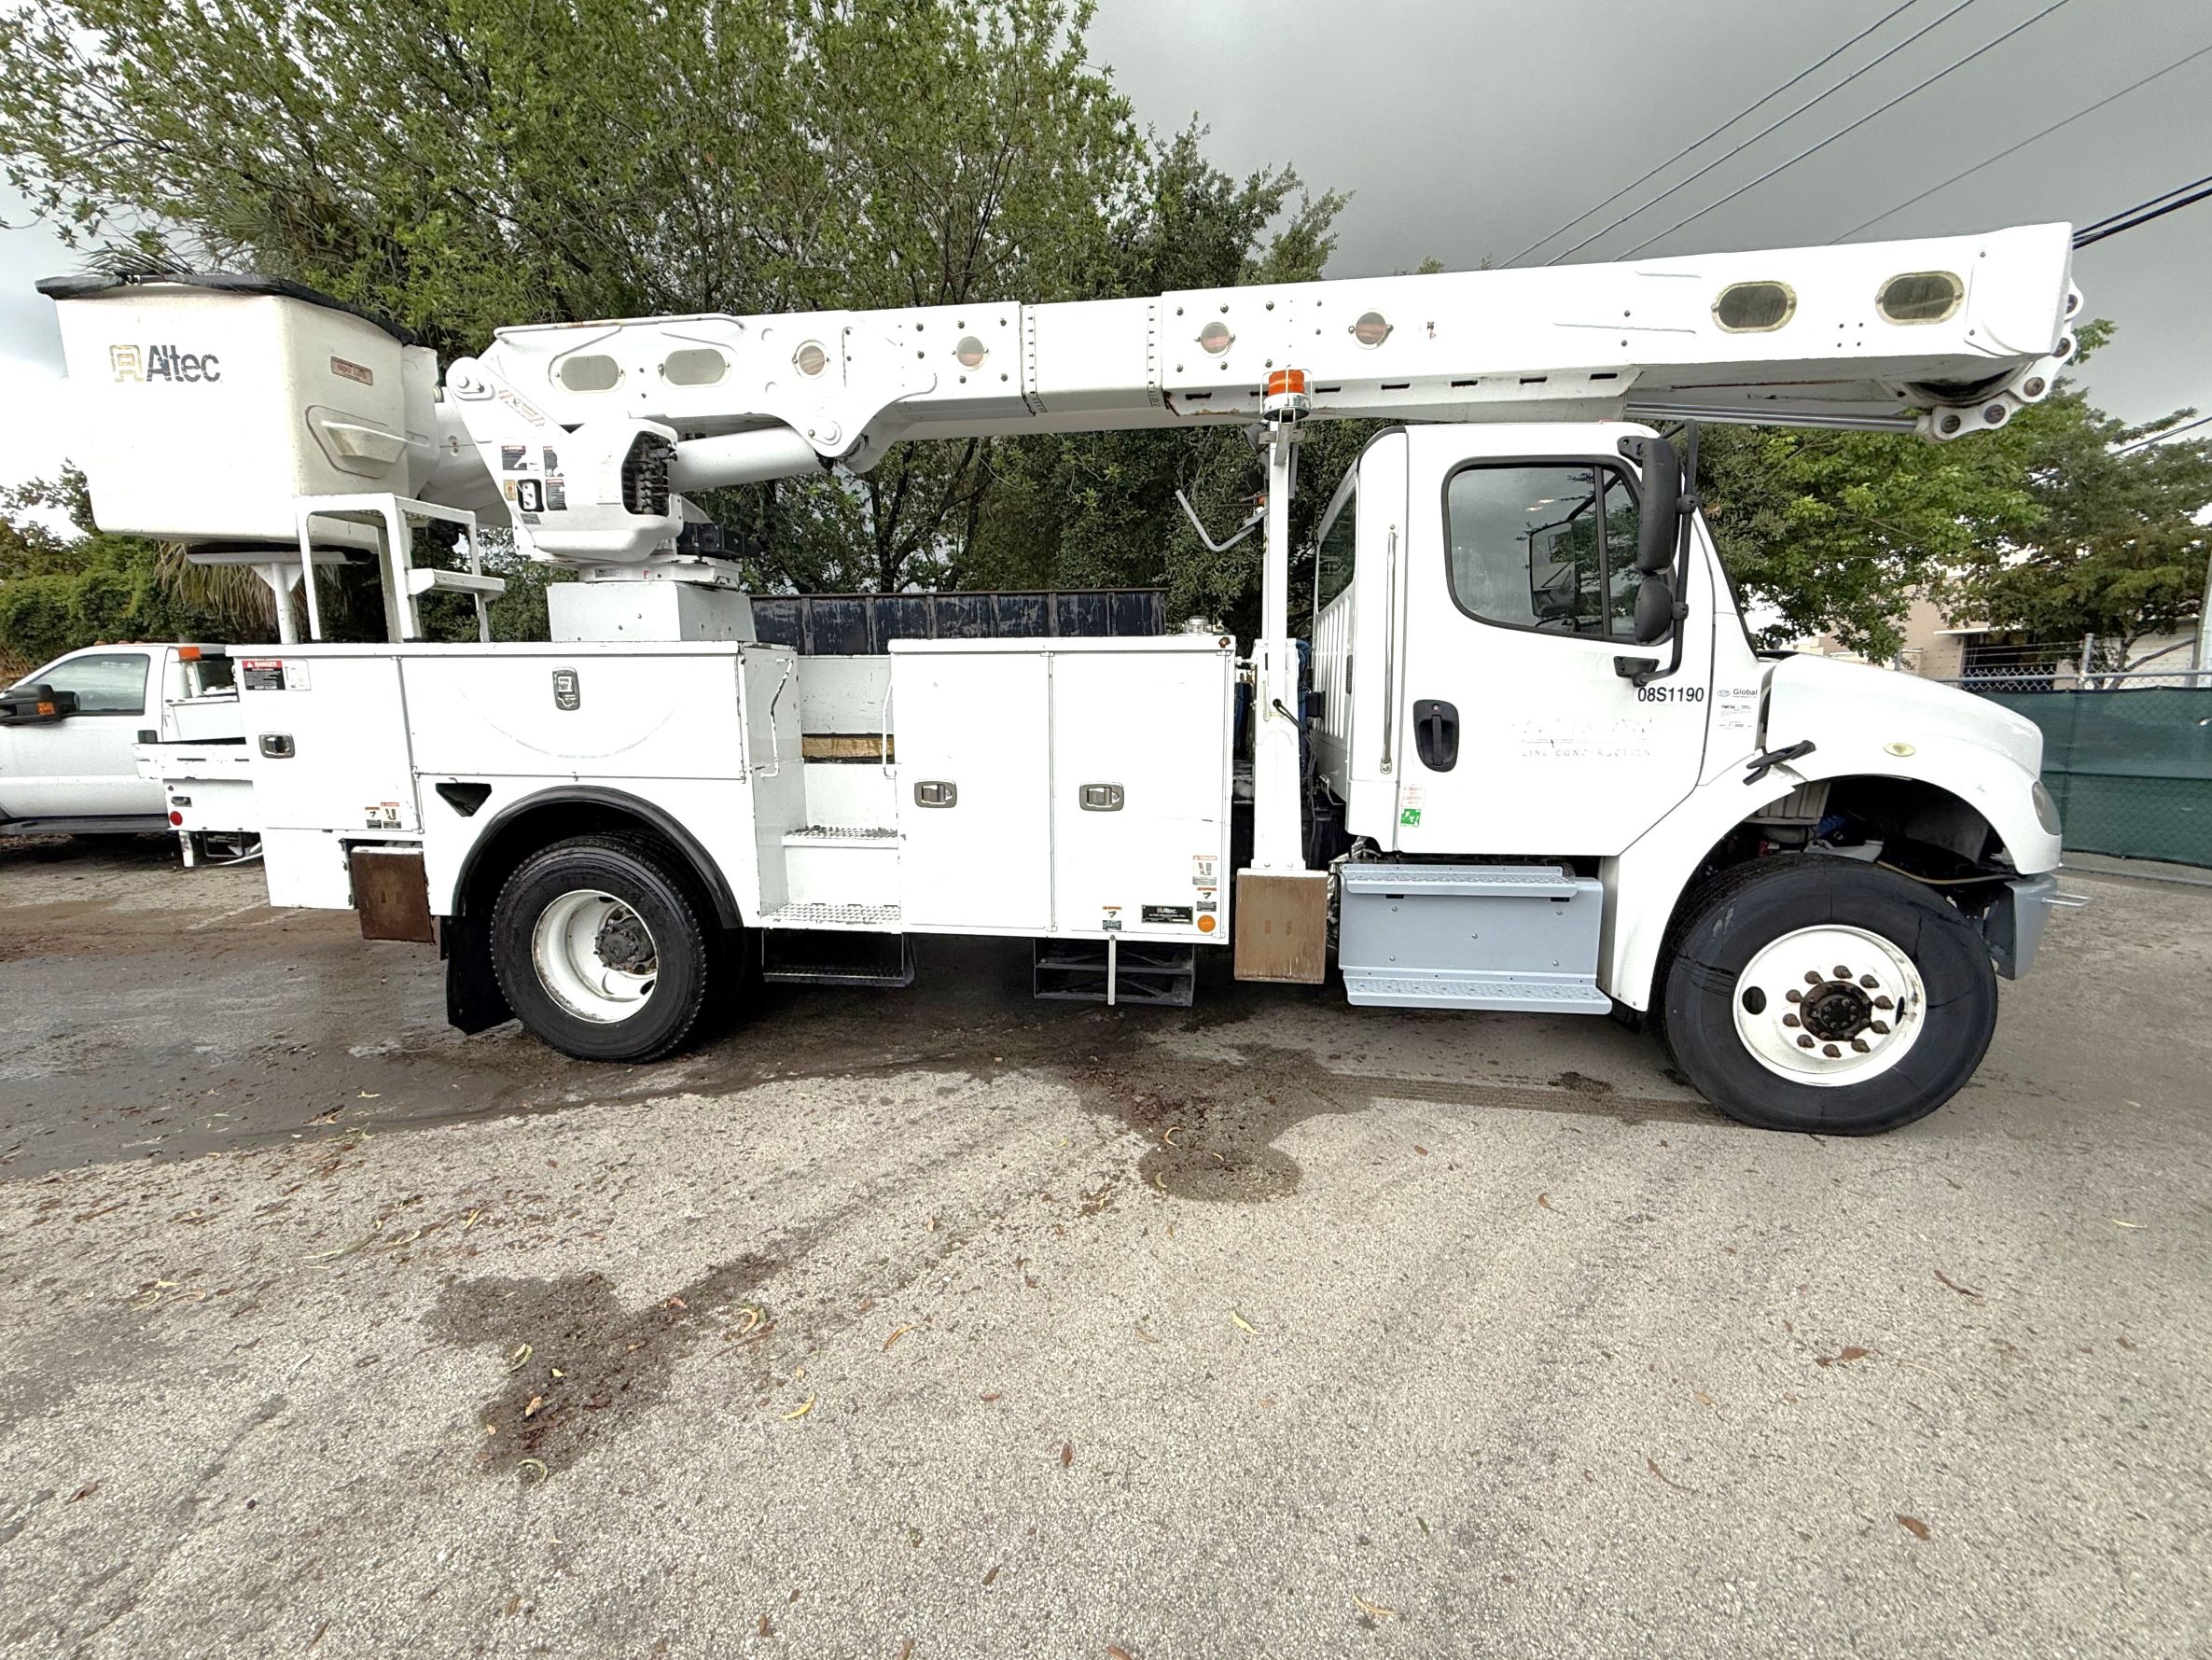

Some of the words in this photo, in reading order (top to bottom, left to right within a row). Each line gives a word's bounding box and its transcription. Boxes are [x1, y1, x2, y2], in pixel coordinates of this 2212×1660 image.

[146, 345, 220, 382] Altec
[1637, 687, 1704, 703] 08S1190
[1732, 688, 1759, 696] Global
[1555, 748, 1651, 758] CONSRUCTON
